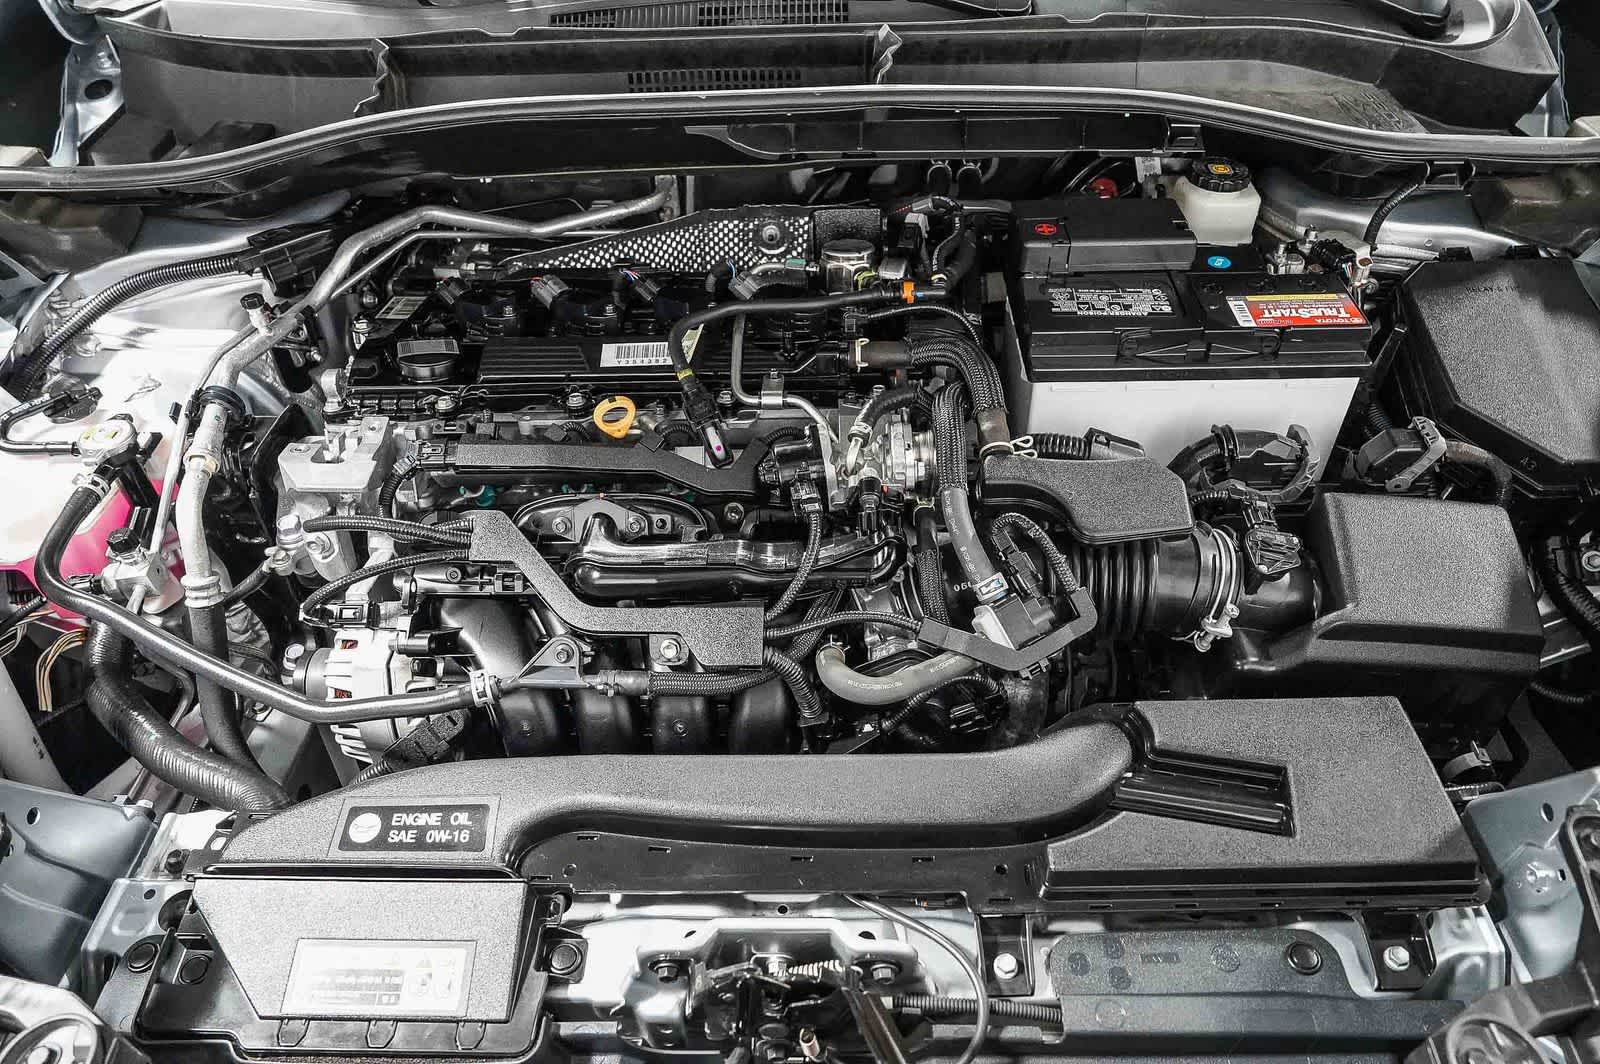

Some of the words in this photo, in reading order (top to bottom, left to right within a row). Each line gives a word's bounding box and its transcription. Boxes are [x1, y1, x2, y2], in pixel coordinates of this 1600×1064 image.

[391, 812, 442, 826] ENGINE
[450, 812, 473, 825] OIL
[387, 830, 417, 843] SAE
[426, 830, 470, 843] 0W-16
